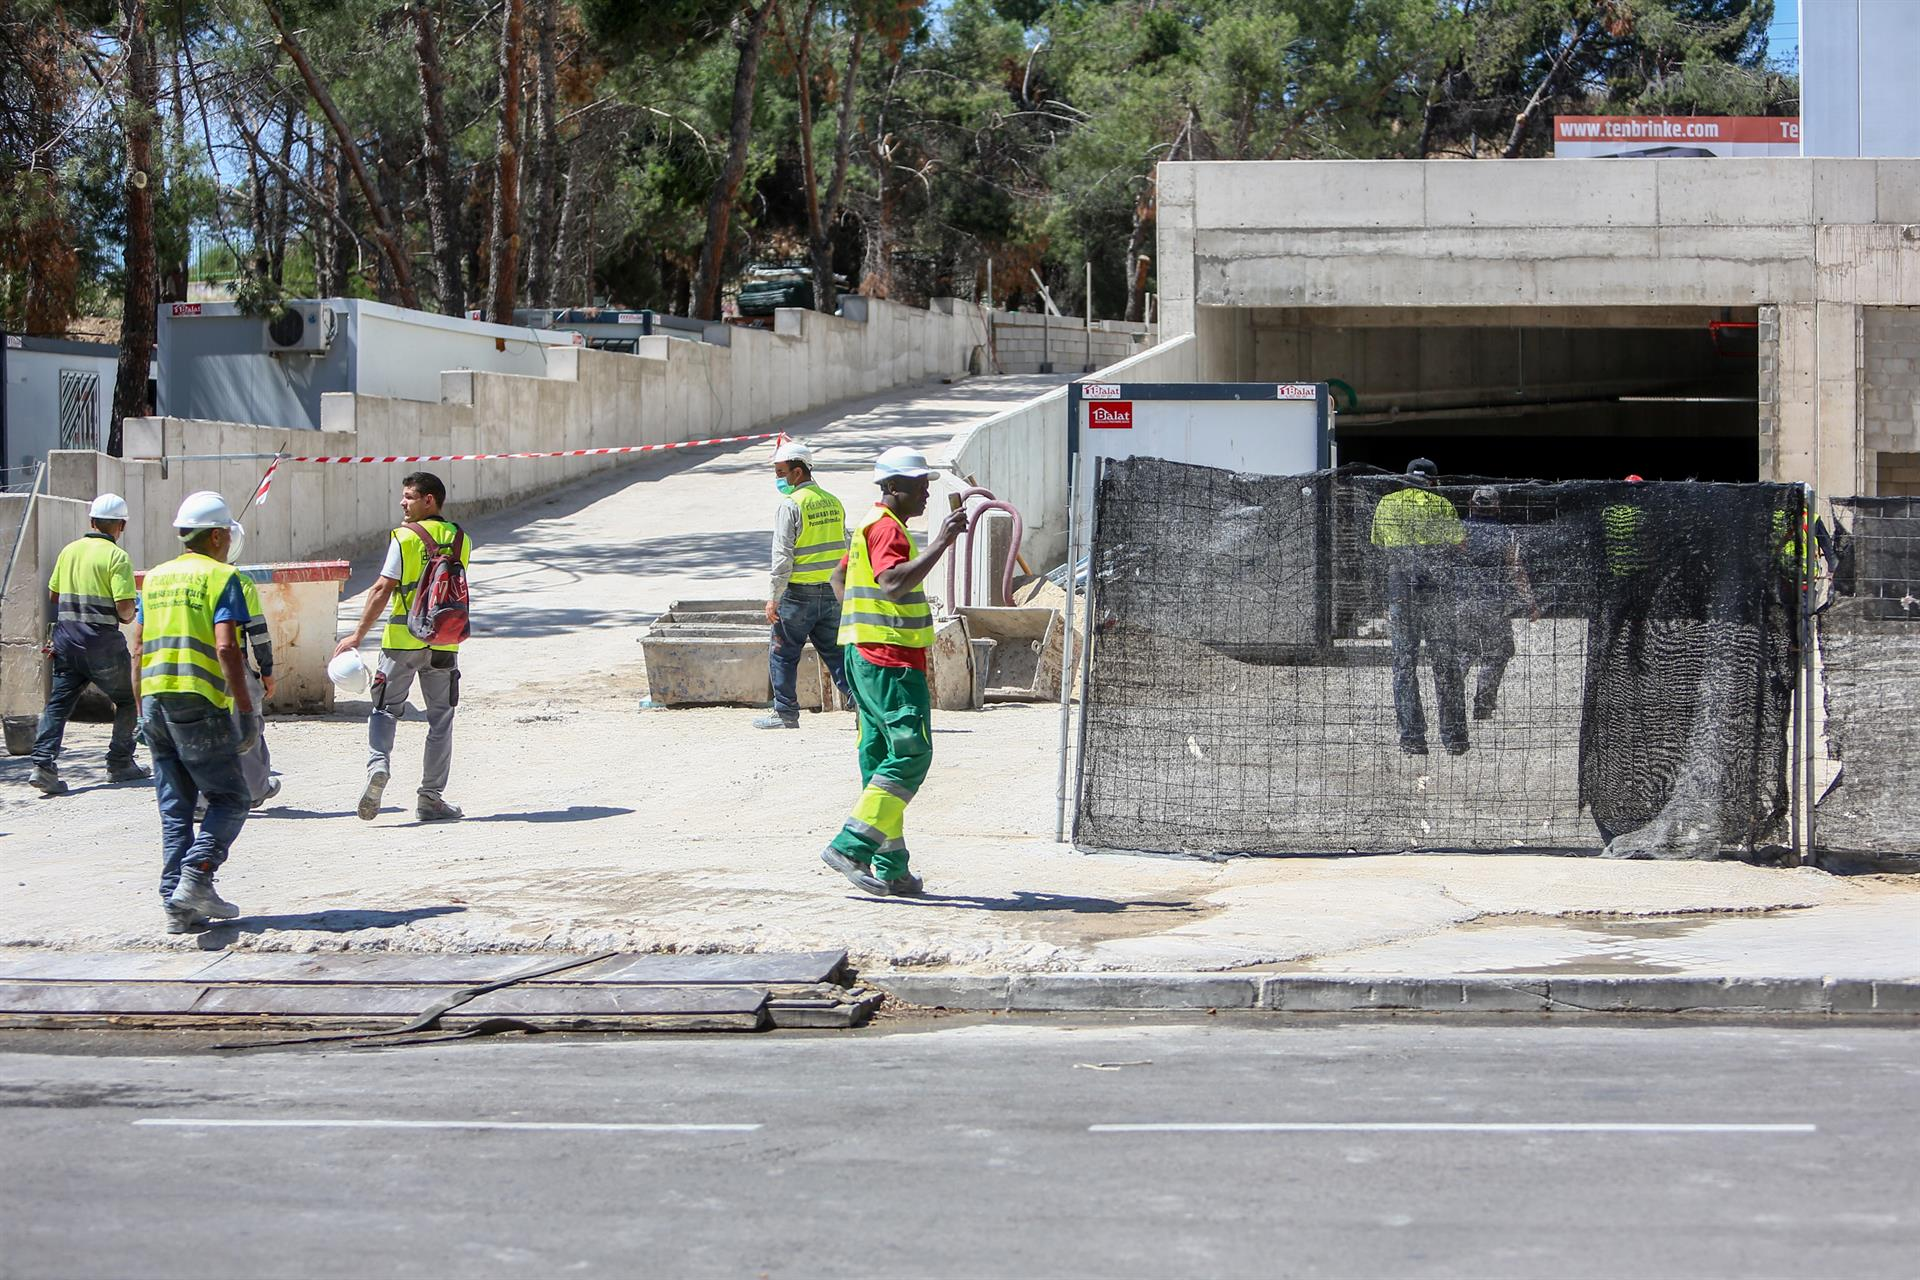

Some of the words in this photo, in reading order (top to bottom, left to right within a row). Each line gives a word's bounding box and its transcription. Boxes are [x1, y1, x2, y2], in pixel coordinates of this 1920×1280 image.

[1560, 120, 1719, 138] www.tenbrinke.com
[1284, 385, 1315, 396] Balat
[1094, 408, 1131, 421] Balat
